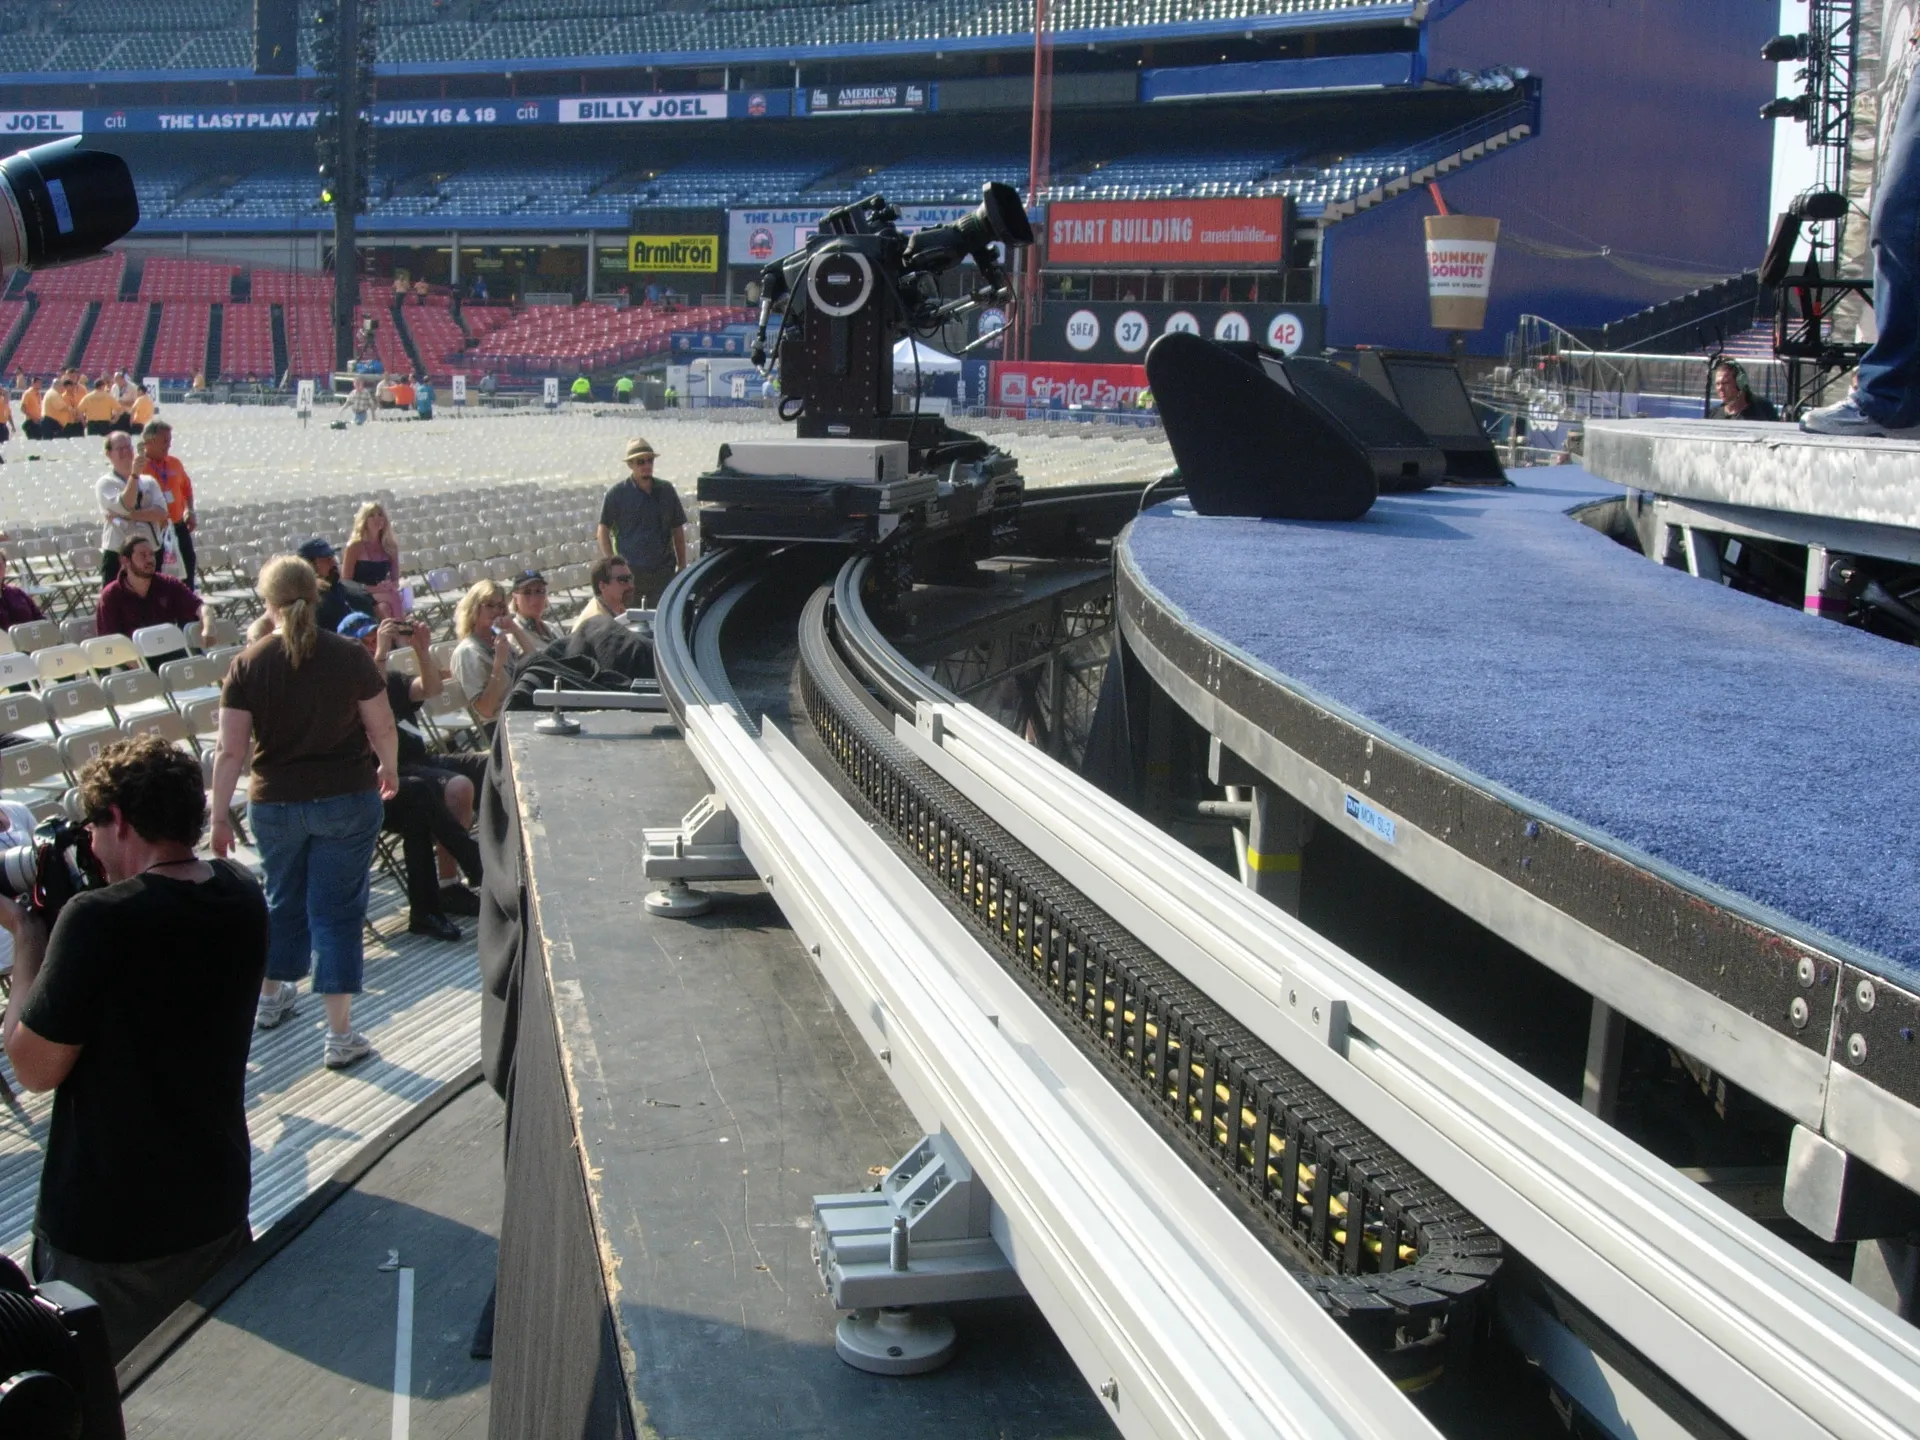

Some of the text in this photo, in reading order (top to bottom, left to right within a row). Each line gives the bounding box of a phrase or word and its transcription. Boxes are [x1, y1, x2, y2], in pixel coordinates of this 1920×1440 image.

[838, 87, 897, 99] AMERICA'S
[384, 109, 428, 124] JULY
[431, 108, 452, 123] 16
[456, 107, 470, 122] &
[474, 107, 497, 122] 18
[516, 106, 538, 120] citi
[578, 98, 707, 119] BILLY JOEL
[6, 114, 64, 131] JOEL
[104, 113, 126, 128] citi
[159, 115, 194, 129] THE
[197, 114, 245, 129] LAST
[247, 112, 294, 127] PLAY
[295, 111, 320, 126] AT
[744, 212, 769, 224] THE
[773, 211, 808, 223] LAST
[914, 209, 949, 221] JULY
[1053, 217, 1194, 244] START BUILDING
[635, 241, 712, 263] Armitron
[1432, 251, 1488, 265] DUNKIN'
[1432, 265, 1485, 278] DONUTS
[1070, 322, 1095, 338] SHEA
[1122, 322, 1142, 342] 37
[1222, 323, 1240, 341] 41
[1274, 324, 1295, 344] 42
[1031, 377, 1088, 404] State
[4, 665, 13, 674] 20
[18, 761, 28, 772] 16
[1361, 807, 1374, 826] MON
